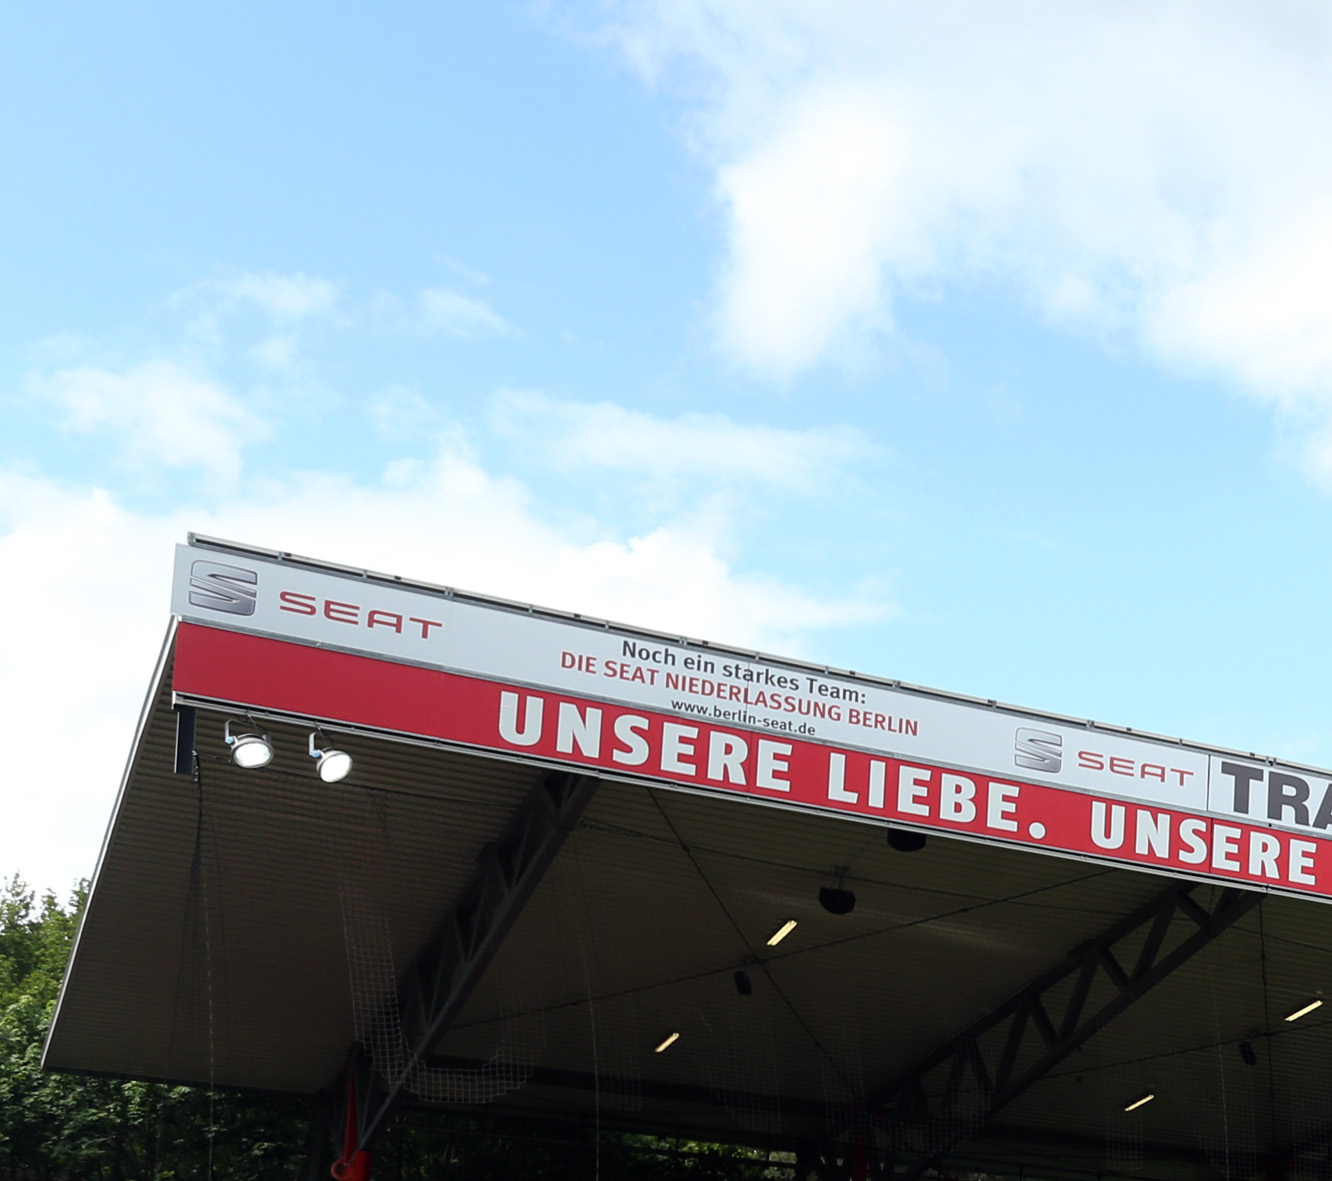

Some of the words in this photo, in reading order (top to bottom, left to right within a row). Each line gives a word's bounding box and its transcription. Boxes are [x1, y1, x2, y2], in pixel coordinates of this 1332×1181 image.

[280, 591, 442, 639] SEAT
[561, 651, 597, 674] DIE
[604, 660, 659, 685] SEAT
[665, 672, 842, 721] NIEDERLASSUNG
[848, 709, 919, 737] BERLIN
[623, 640, 676, 666] Noch
[683, 655, 715, 674] ein
[722, 661, 799, 691] starkes
[806, 677, 867, 704] Team:
[671, 700, 816, 736] www.berlin-seat.de
[499, 690, 793, 793] UNSERE
[827, 753, 1047, 841] LIEBE.
[1090, 800, 1318, 886] UNSERE
[1078, 750, 1195, 787] SEAT
